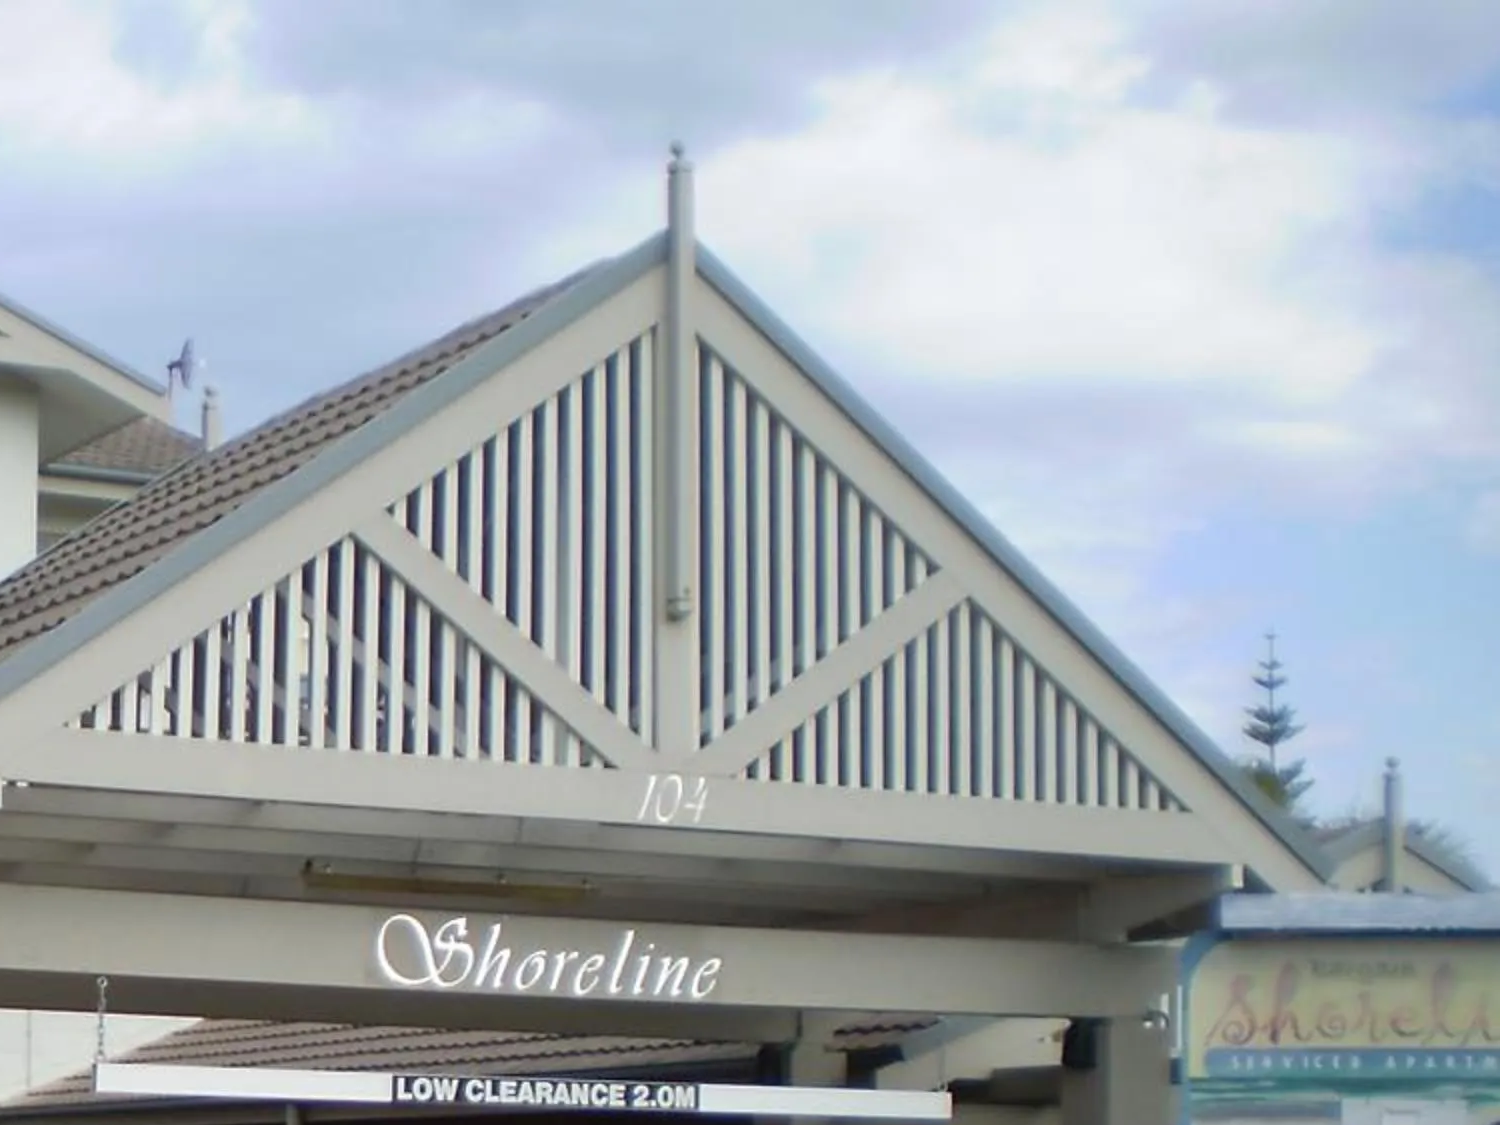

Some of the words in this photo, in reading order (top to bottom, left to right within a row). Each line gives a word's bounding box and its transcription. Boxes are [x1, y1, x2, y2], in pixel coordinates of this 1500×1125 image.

[636, 774, 709, 823] 104
[376, 913, 723, 999] Shoreline
[398, 1077, 458, 1101] LOW
[465, 1079, 625, 1106] CLEARANCE
[632, 1084, 695, 1109] 2.0M
